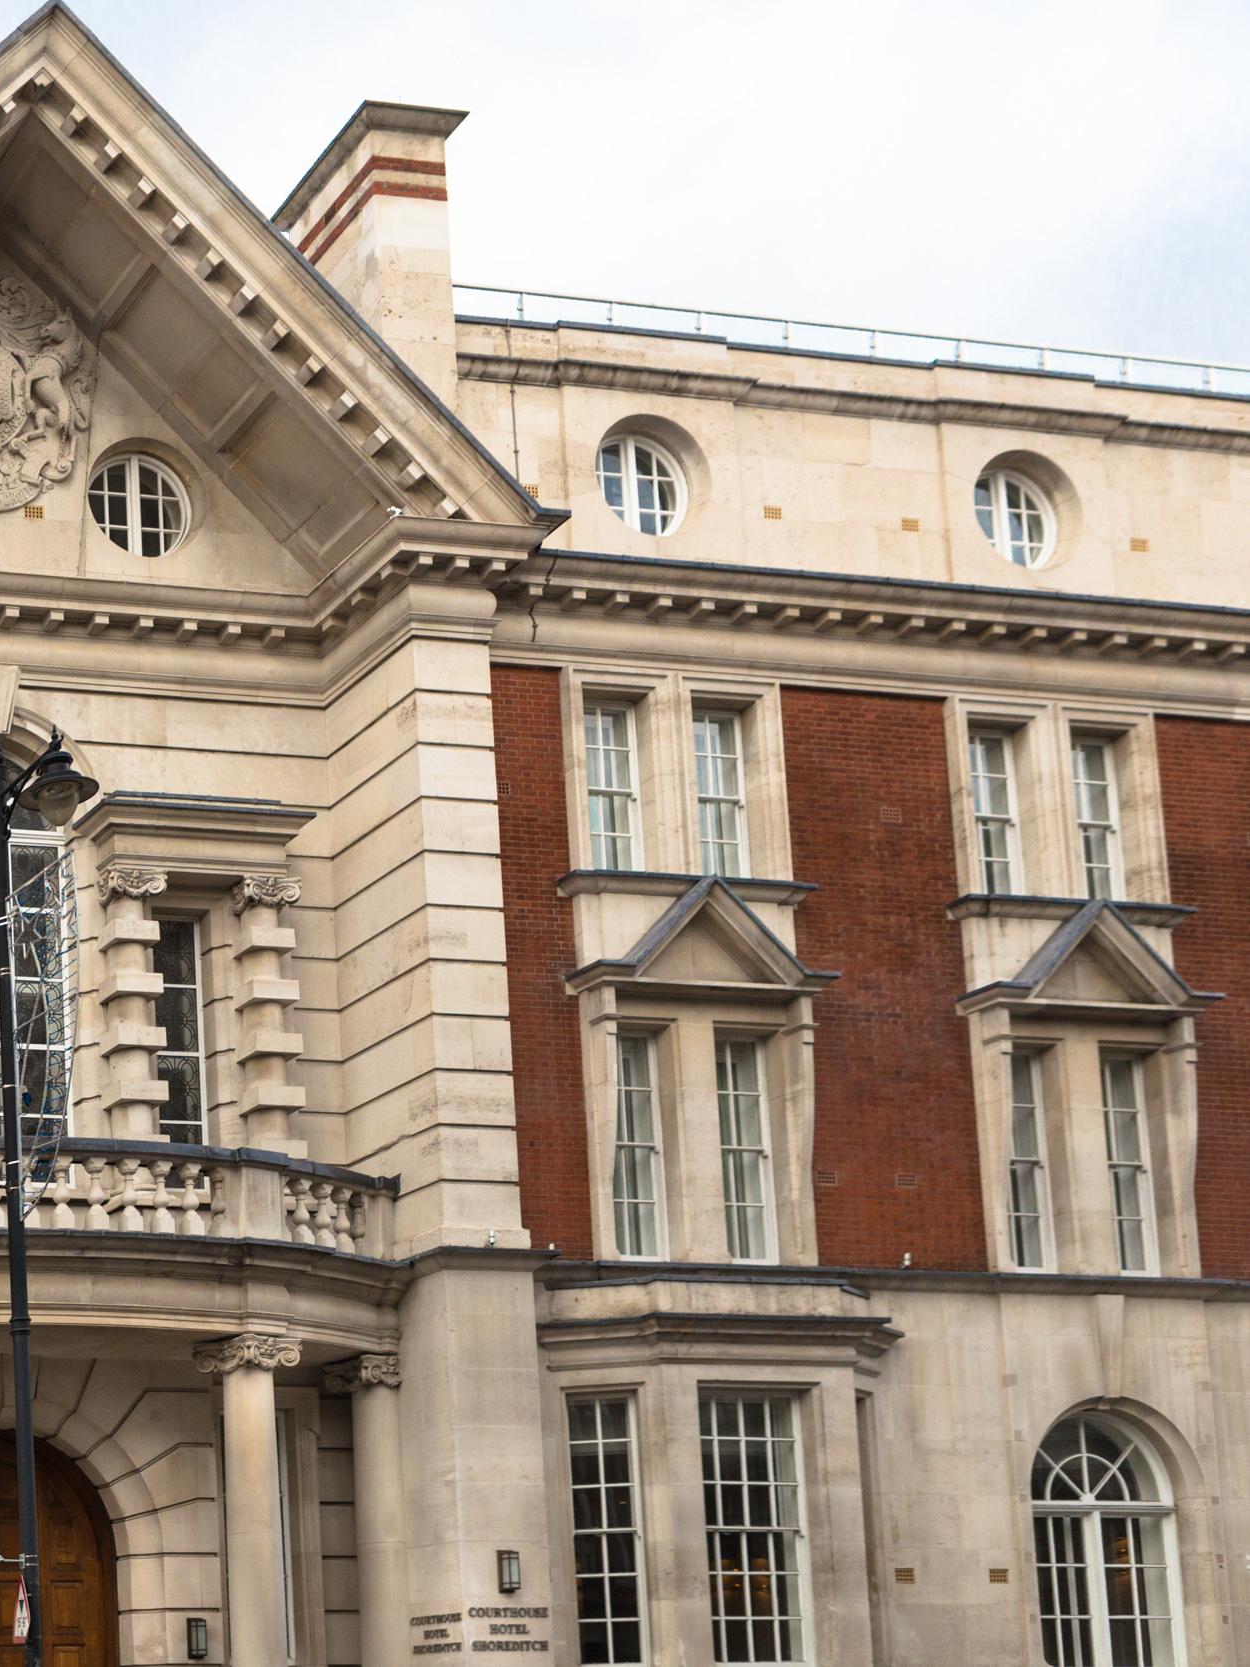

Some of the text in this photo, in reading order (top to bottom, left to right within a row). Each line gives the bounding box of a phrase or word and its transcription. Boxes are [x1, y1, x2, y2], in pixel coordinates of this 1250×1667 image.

[468, 1607, 548, 1618] COURTHOUSE
[410, 1613, 462, 1626] COURTHOUSE
[424, 1629, 449, 1640] HOTEL
[490, 1624, 529, 1635] HOTEL
[472, 1641, 548, 1651] SHOREDITCH
